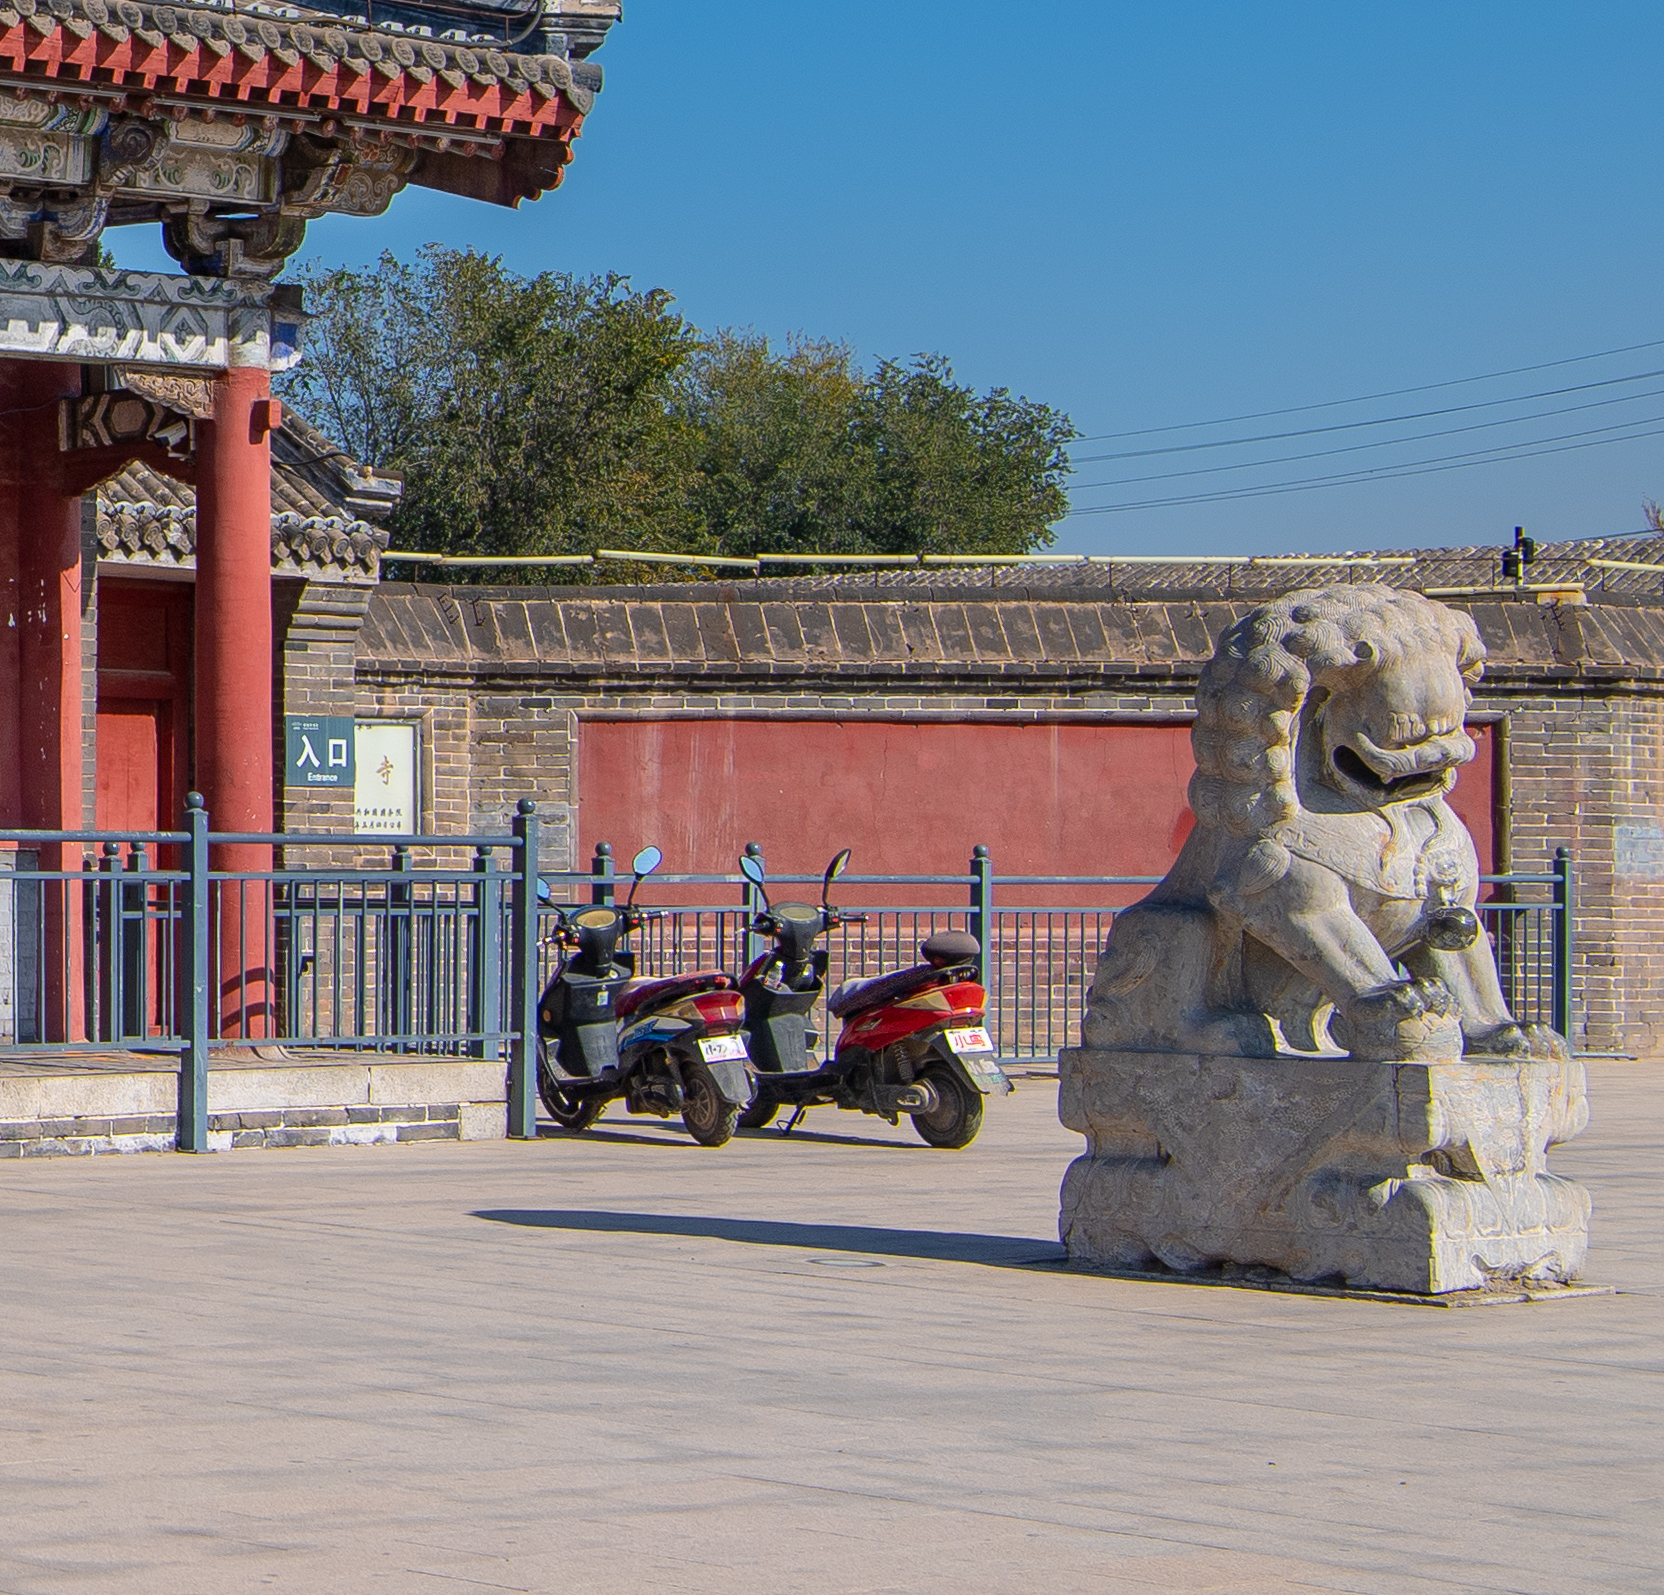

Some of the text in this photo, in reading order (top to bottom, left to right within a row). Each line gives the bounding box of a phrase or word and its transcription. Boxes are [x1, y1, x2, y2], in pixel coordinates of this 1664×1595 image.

[295, 734, 349, 768] 入口
[307, 772, 339, 782] Entrance
[375, 755, 394, 786] 寺
